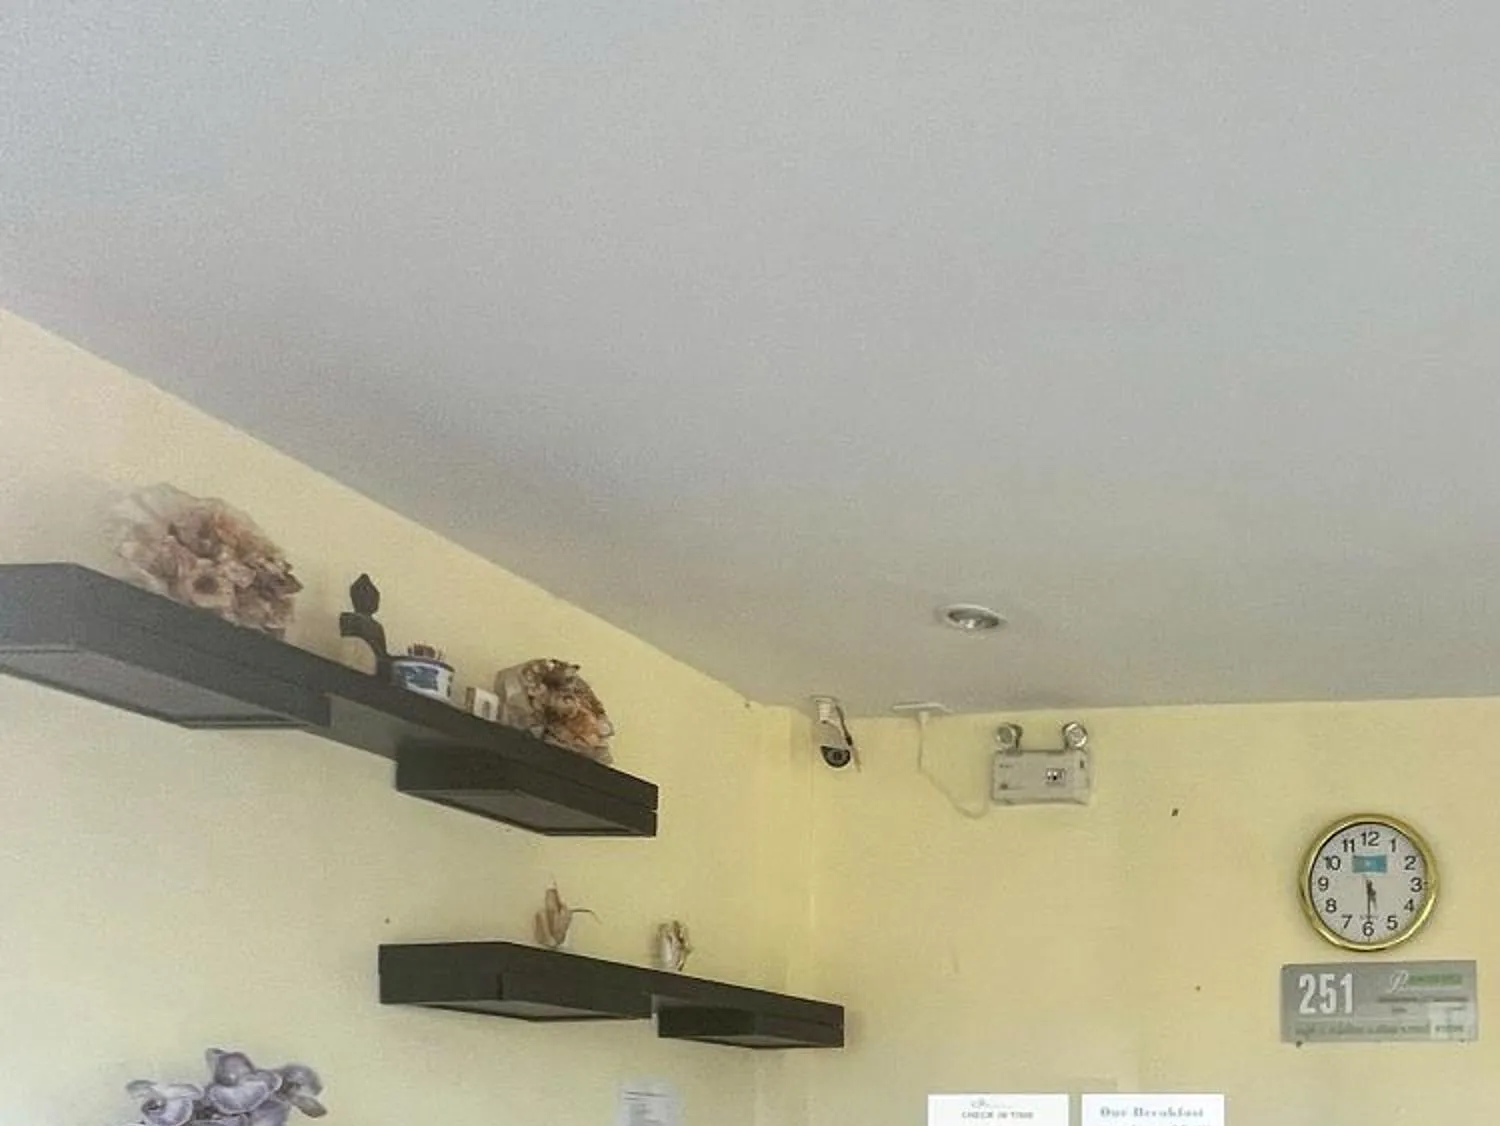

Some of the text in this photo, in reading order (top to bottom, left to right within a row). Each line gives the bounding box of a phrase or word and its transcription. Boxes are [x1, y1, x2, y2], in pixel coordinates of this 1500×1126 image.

[1342, 839, 1356, 852] 11
[1361, 832, 1379, 847] 12
[1390, 839, 1397, 851] 1
[1324, 856, 1341, 871] 10
[1404, 856, 1416, 871] 2
[1318, 877, 1329, 892] 9
[1411, 877, 1422, 892] 3
[1325, 898, 1337, 913] 8
[1404, 899, 1414, 912] 4
[1342, 915, 1352, 929] 7
[1363, 921, 1374, 936] 6
[1386, 916, 1398, 930] 5
[1299, 973, 1353, 1014] 251
[1100, 1106, 1204, 1118] Our Breakfast
